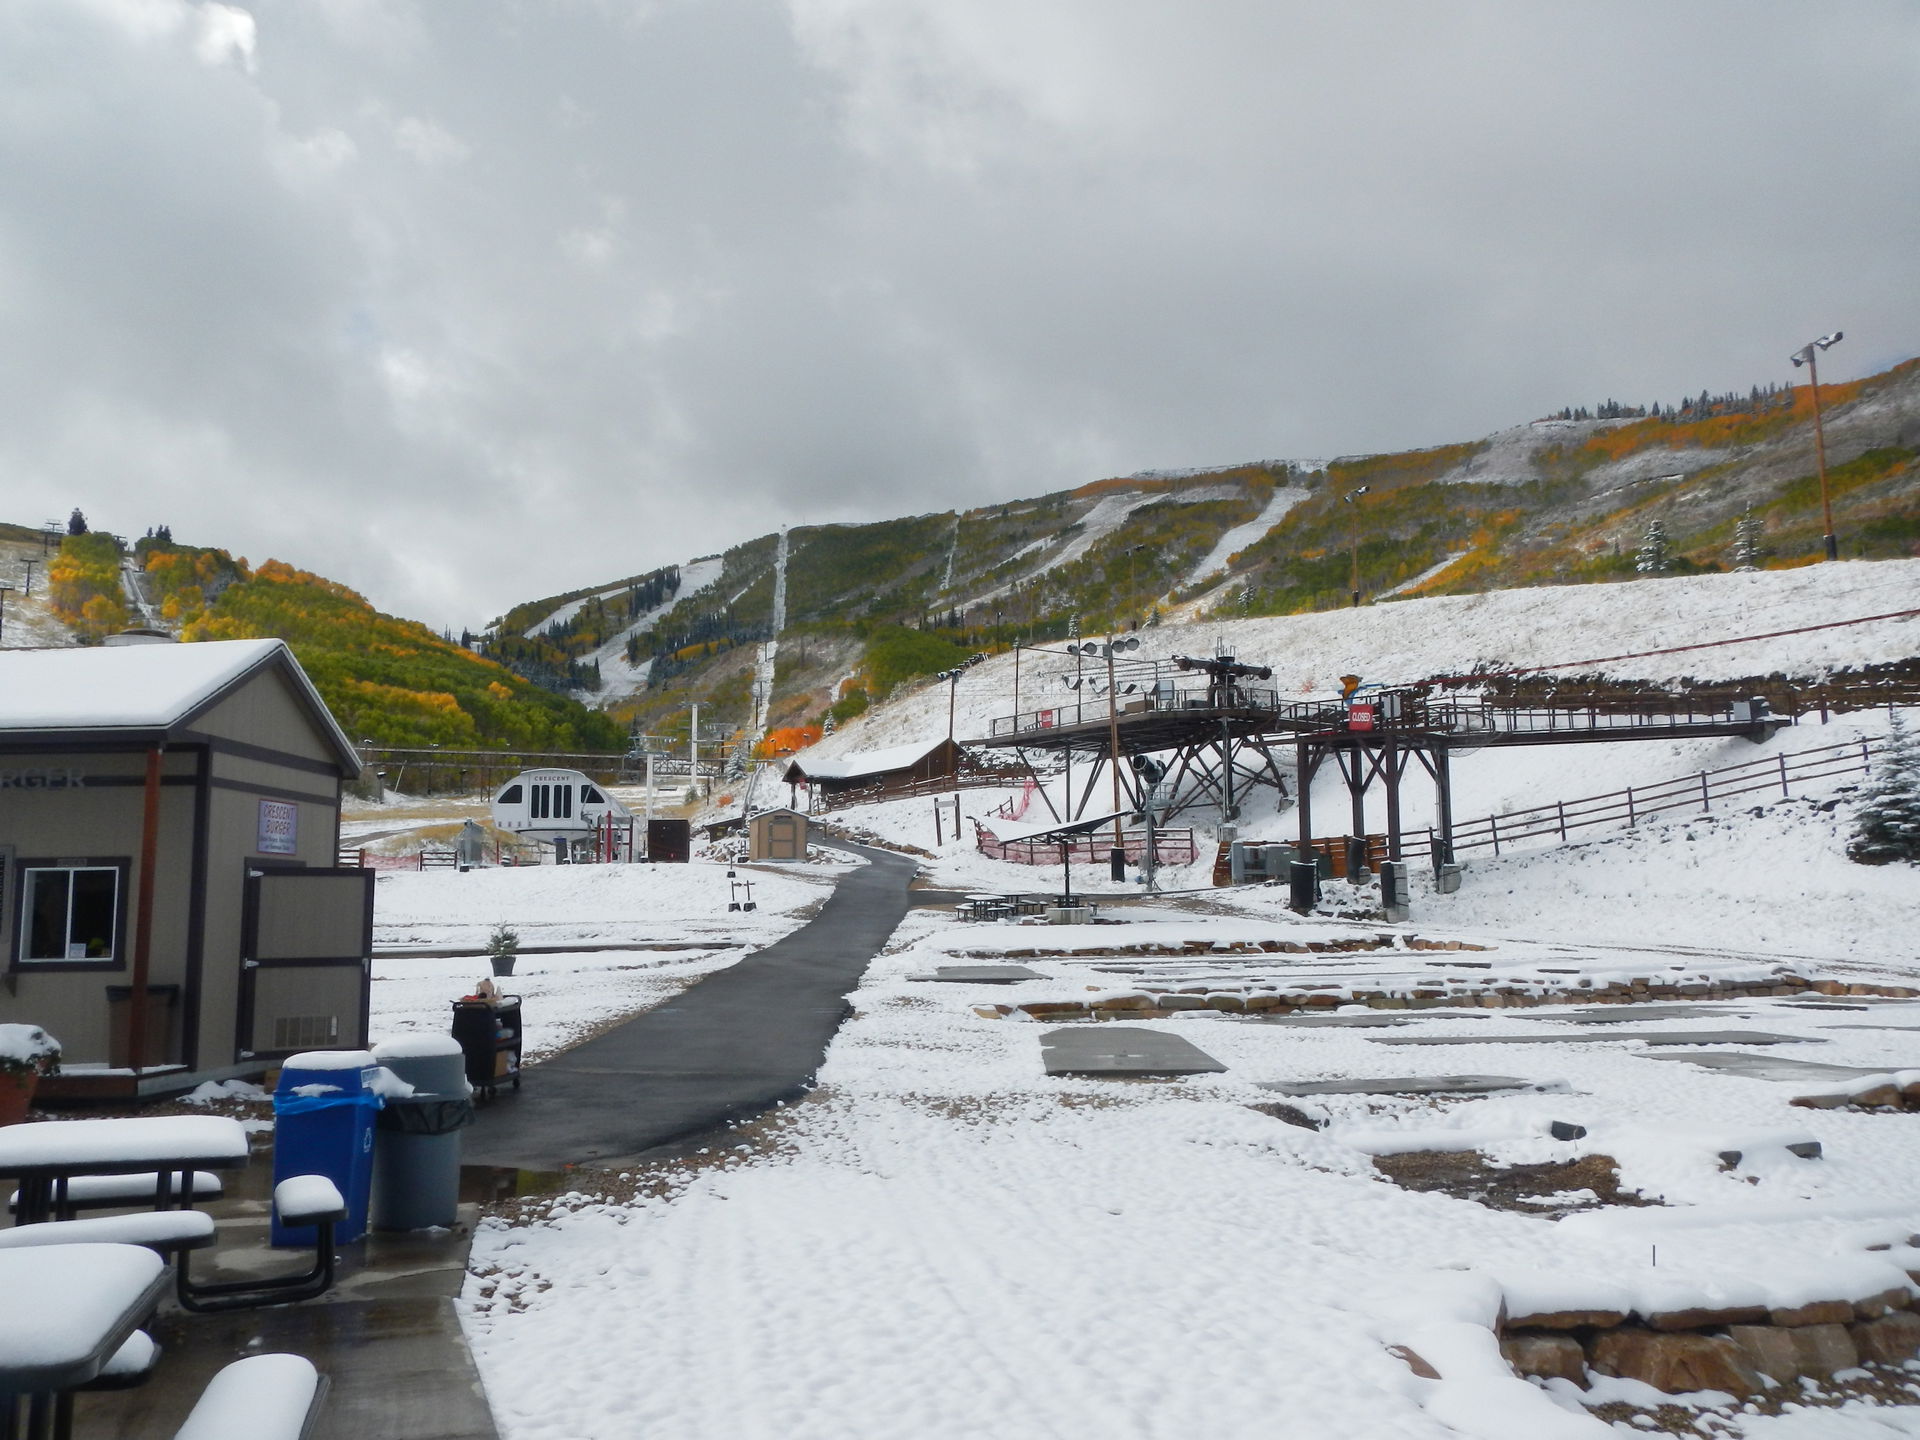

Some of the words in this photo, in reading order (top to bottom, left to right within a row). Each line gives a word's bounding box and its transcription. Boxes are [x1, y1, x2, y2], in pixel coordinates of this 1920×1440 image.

[1352, 712, 1371, 722] CLOSED
[263, 804, 295, 820] CRESCENT
[265, 819, 290, 835] BURGER
